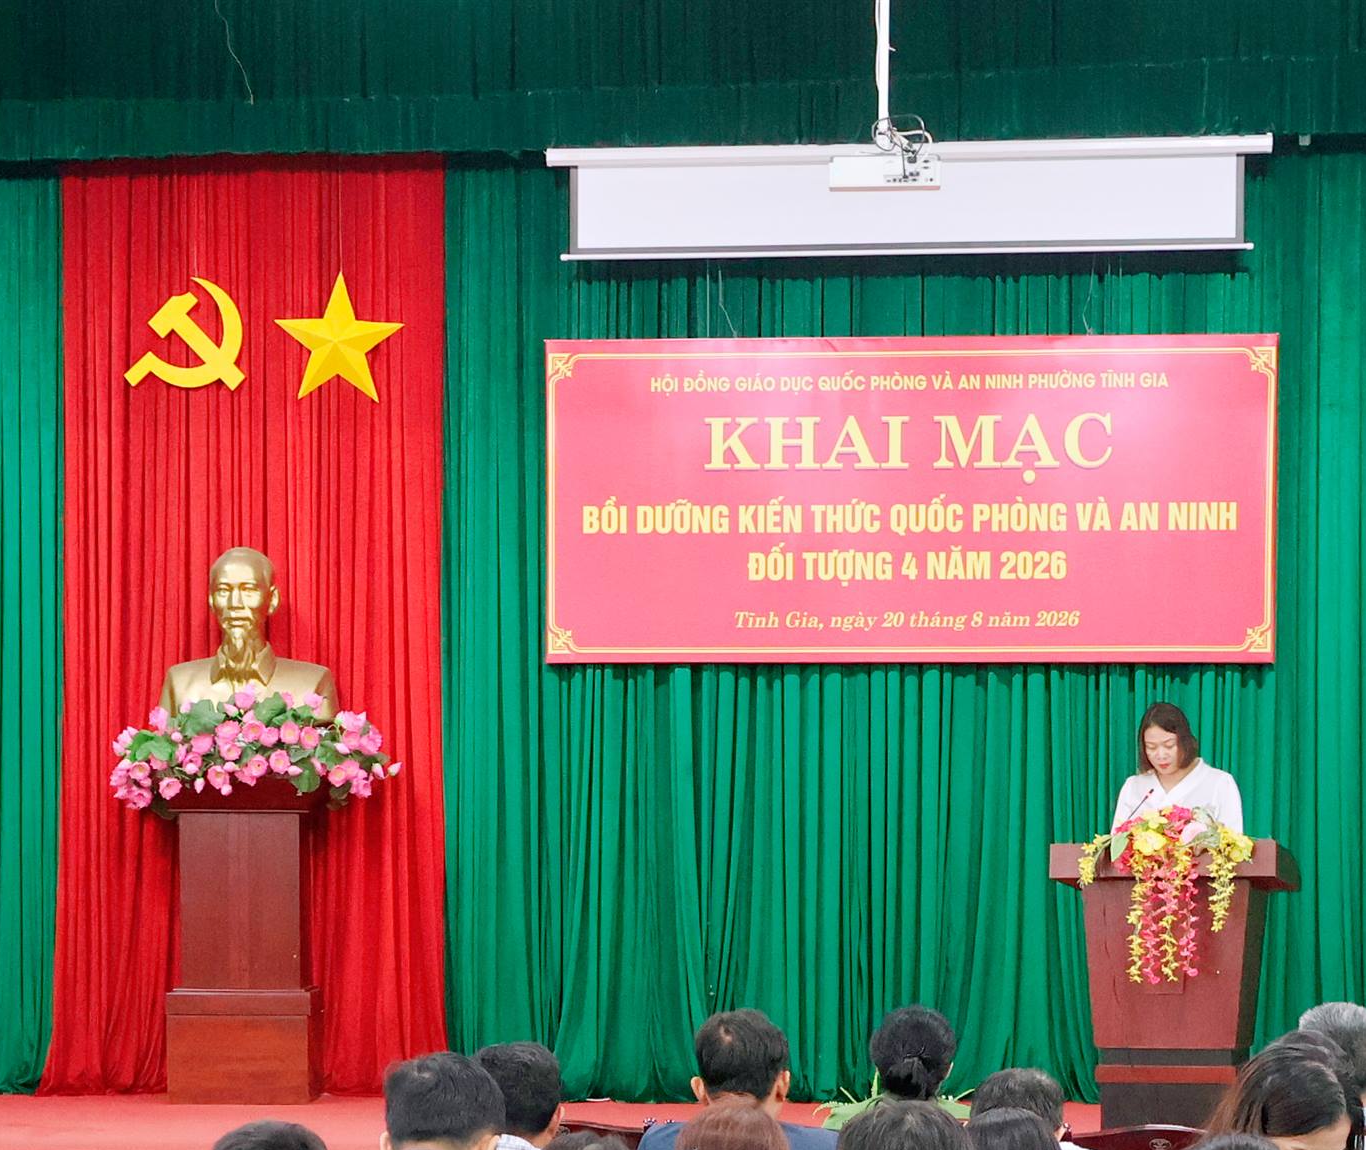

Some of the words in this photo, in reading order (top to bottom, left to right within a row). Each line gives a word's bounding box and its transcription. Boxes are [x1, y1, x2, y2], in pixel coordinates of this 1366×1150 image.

[651, 374, 679, 395] HỘI
[683, 370, 731, 392] ĐỒNG
[735, 374, 776, 391] GIÁO
[779, 376, 812, 394] DỤC
[818, 370, 865, 391] QUỐC
[870, 372, 927, 390] PHÒNG
[932, 371, 953, 389] VÀ
[959, 375, 981, 389] AN
[985, 375, 1023, 388] NINH
[1028, 370, 1096, 388] PHƯỜNG
[1100, 370, 1135, 387] TĨNH
[1140, 373, 1168, 387] GIA
[705, 416, 909, 469] KHAI
[934, 413, 1112, 483] MẠC
[583, 496, 628, 534] BỒI
[636, 499, 730, 533] DƯỠNG
[739, 496, 802, 533] KIẾN
[811, 499, 881, 533] THỨC
[890, 494, 964, 535] QUỐC
[973, 496, 1067, 532] PHÒNG
[1076, 497, 1111, 531] VÀ
[1120, 503, 1159, 530] AN
[1169, 502, 1237, 530] NINH
[748, 543, 794, 580] ĐỐI
[803, 549, 893, 586] TƯỢNG
[901, 552, 918, 580] 4
[927, 546, 991, 579] NĂM
[1000, 551, 1067, 579] 2026
[735, 612, 779, 628] Tĩnh
[786, 612, 824, 630] Gia,
[831, 612, 877, 631] ngày
[883, 612, 905, 627] 20
[909, 611, 966, 631] tháng
[971, 611, 983, 627] 8
[988, 612, 1030, 627] năm
[1035, 611, 1080, 626] 2026
